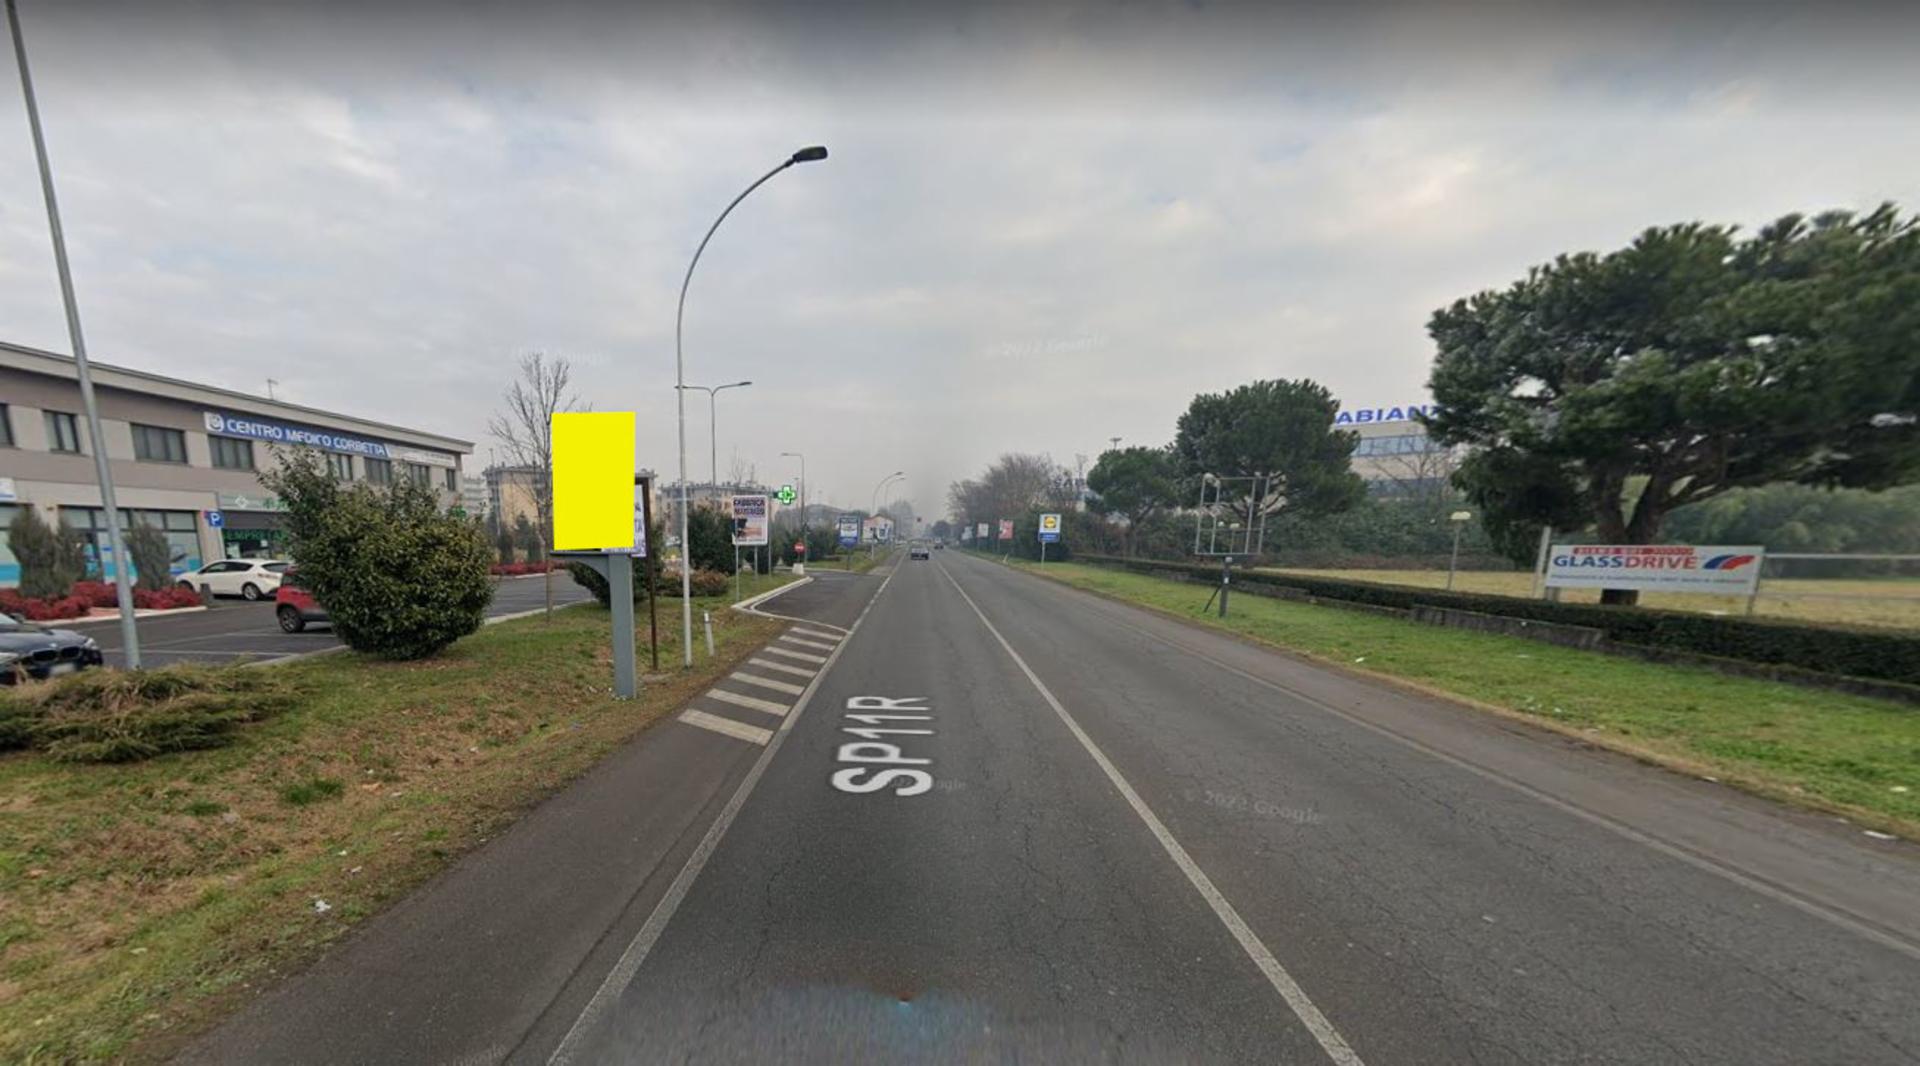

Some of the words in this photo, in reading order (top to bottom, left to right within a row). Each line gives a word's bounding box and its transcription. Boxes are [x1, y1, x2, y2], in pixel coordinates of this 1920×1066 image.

[227, 418, 283, 440] CENTRO
[286, 430, 332, 448] MEDICO
[333, 437, 386, 457] CORBETTA
[1552, 554, 1698, 570] GLASSDRIVE
[831, 695, 937, 797] SP11R
